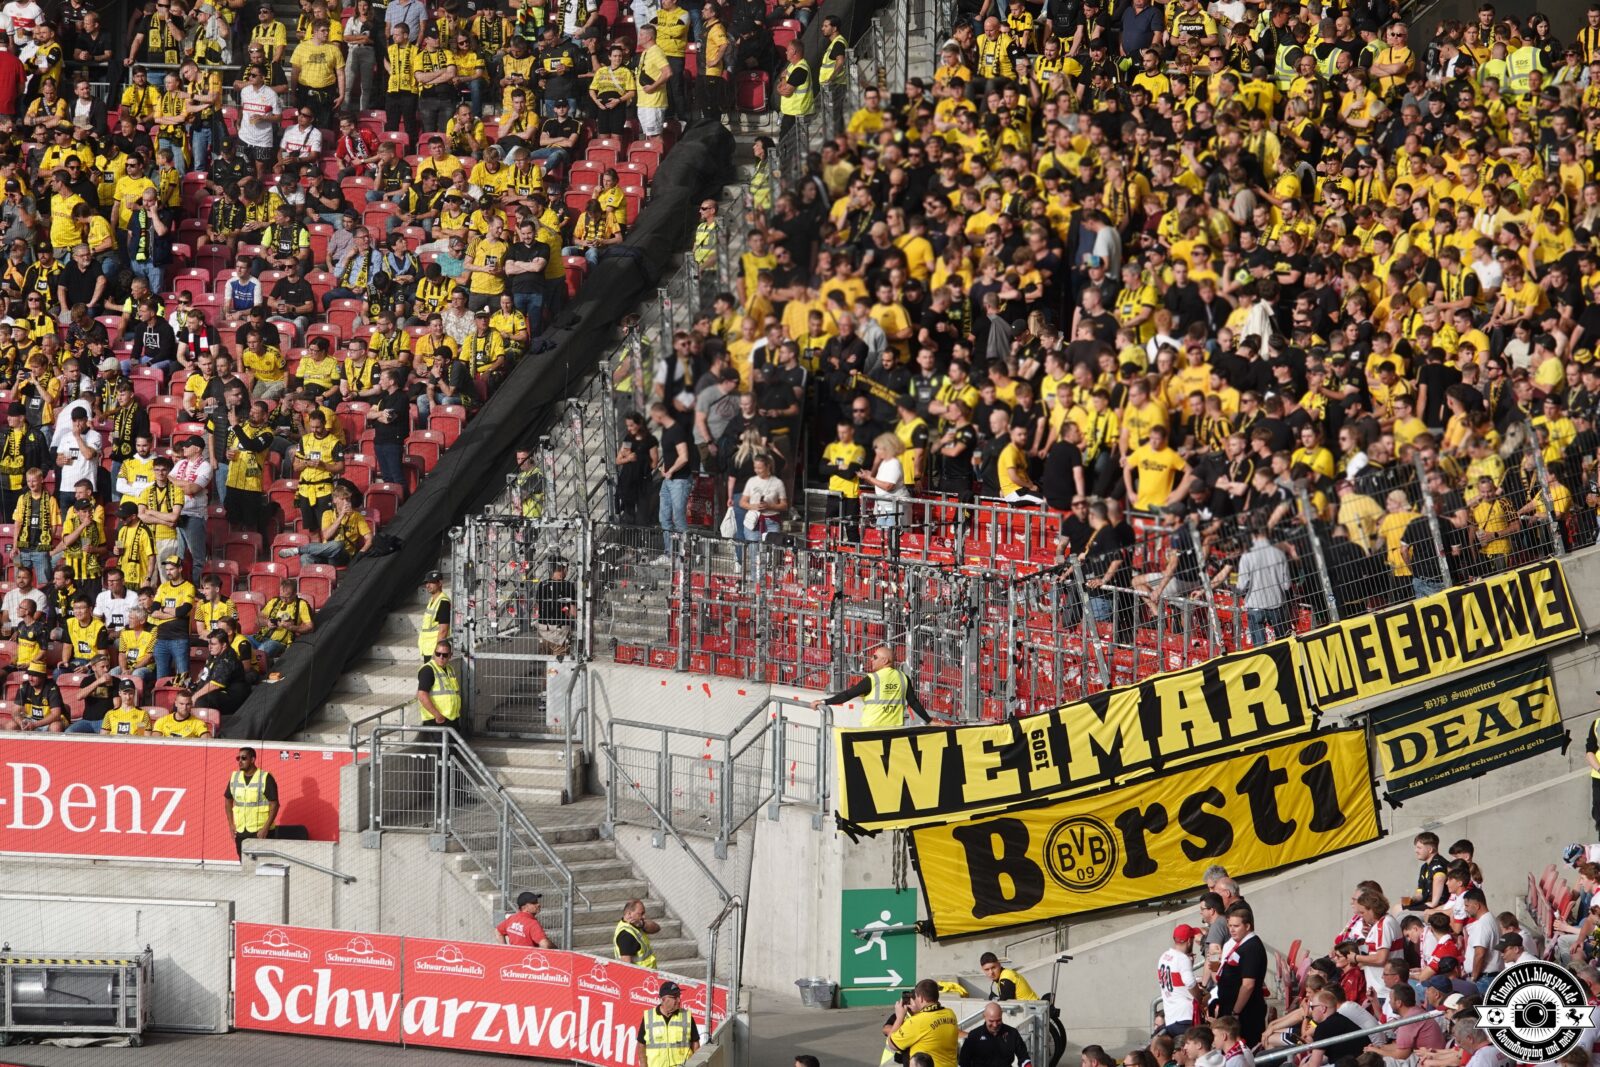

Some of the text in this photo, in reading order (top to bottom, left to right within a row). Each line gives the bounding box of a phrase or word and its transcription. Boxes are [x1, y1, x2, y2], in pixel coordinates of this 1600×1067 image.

[1306, 567, 1566, 698] MEERANE
[1424, 680, 1497, 711] BVB Supporters
[852, 653, 1294, 814] WEIMAR
[1031, 728, 1050, 771] 1909
[1382, 685, 1550, 773] DEAF
[1409, 778, 1424, 789] Ein
[1451, 762, 1471, 776] lang
[1471, 751, 1508, 768] schwarz
[1508, 744, 1526, 757] und
[1526, 738, 1545, 751] gelb
[1056, 825, 1108, 873] BVB
[1076, 866, 1095, 881] 09
[243, 946, 309, 959] Schwarzwaldmilch
[327, 953, 393, 967] Schwarzwaldmilch
[416, 962, 483, 975] Schwarzwaldmilch
[502, 969, 570, 983] Schwarzwaldmilch
[251, 965, 708, 1065] Schwarzwaldm
